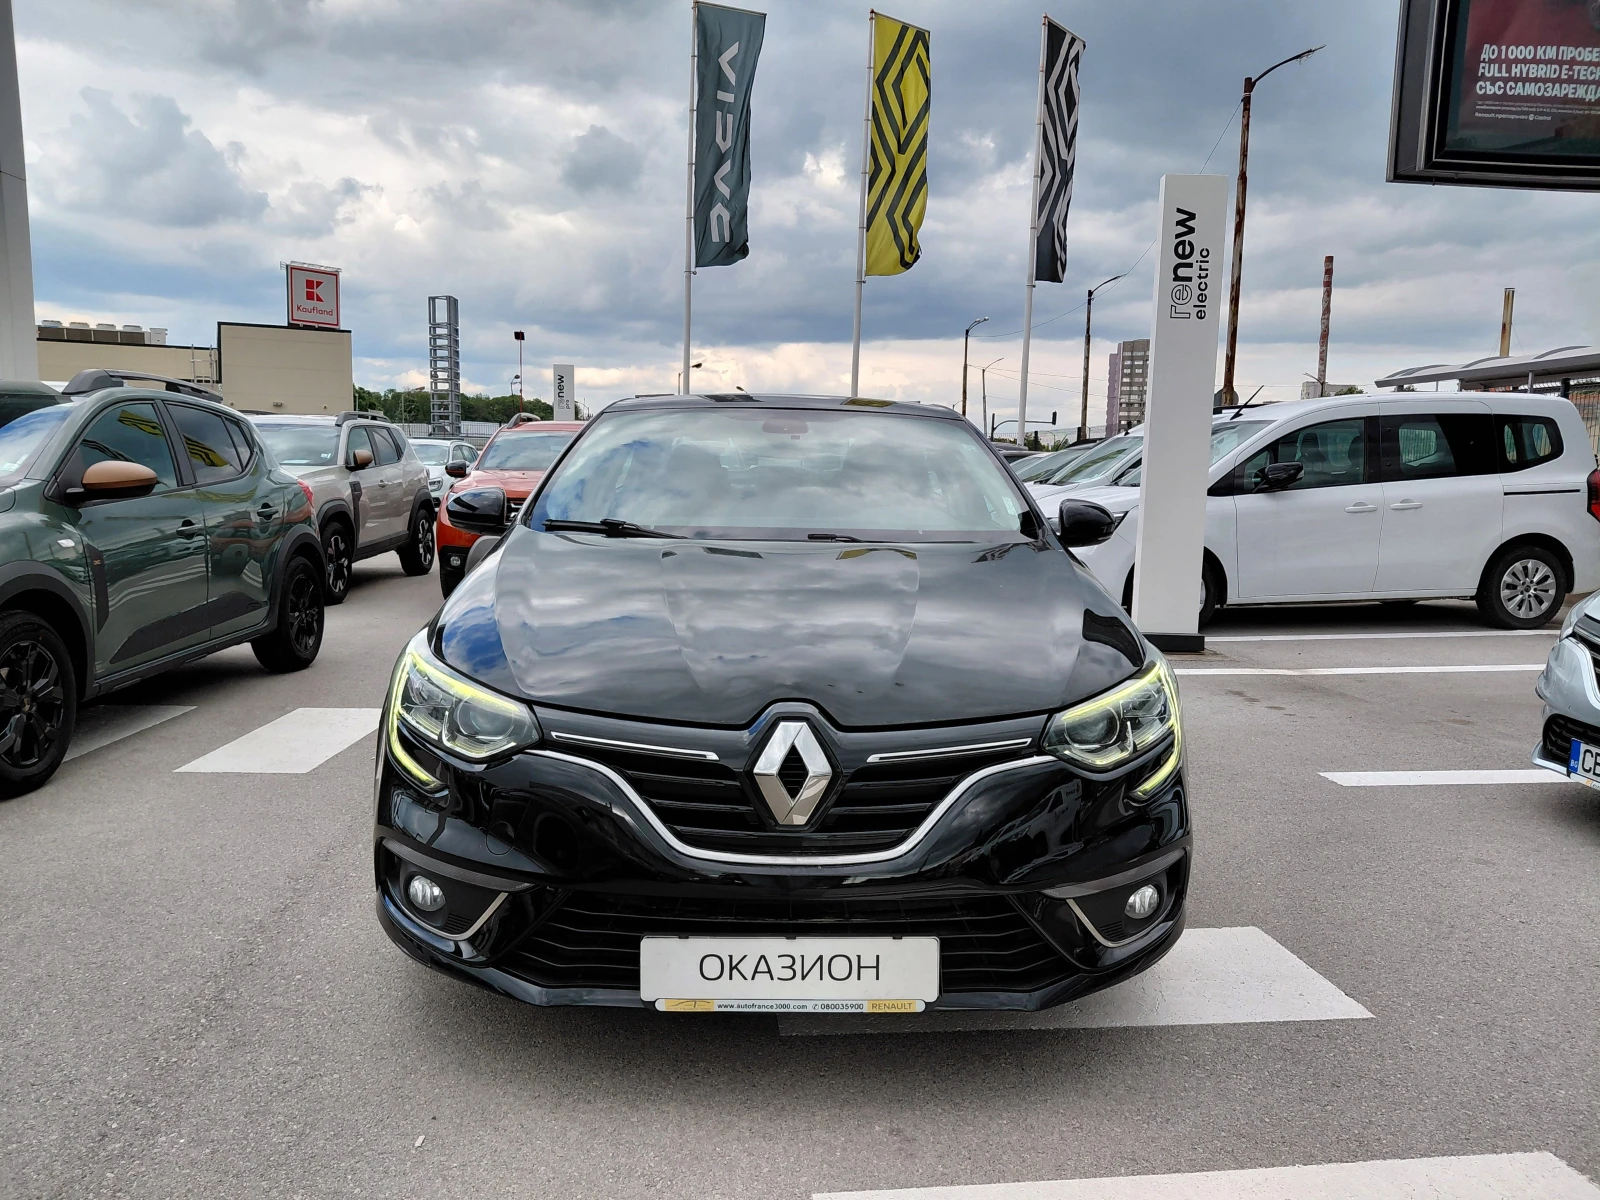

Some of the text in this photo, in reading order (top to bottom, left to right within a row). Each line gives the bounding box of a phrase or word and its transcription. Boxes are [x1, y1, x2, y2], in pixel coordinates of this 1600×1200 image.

[1480, 44, 1498, 62] ДО
[1536, 46, 1557, 60] КМ
[1558, 46, 1600, 62] ПРОБЕ
[1478, 62, 1509, 77] FULL
[1511, 64, 1560, 79] HYBRID
[1476, 81, 1504, 95] СЪС
[1170, 207, 1197, 319] renew
[1193, 247, 1210, 320] electric
[296, 304, 334, 316] Kaufland
[1570, 759, 1578, 768] BG
[699, 953, 880, 981] ОКАЗИОН
[717, 1002, 808, 1010] www.autofrance3000.com
[871, 1002, 913, 1010] RENAULT
